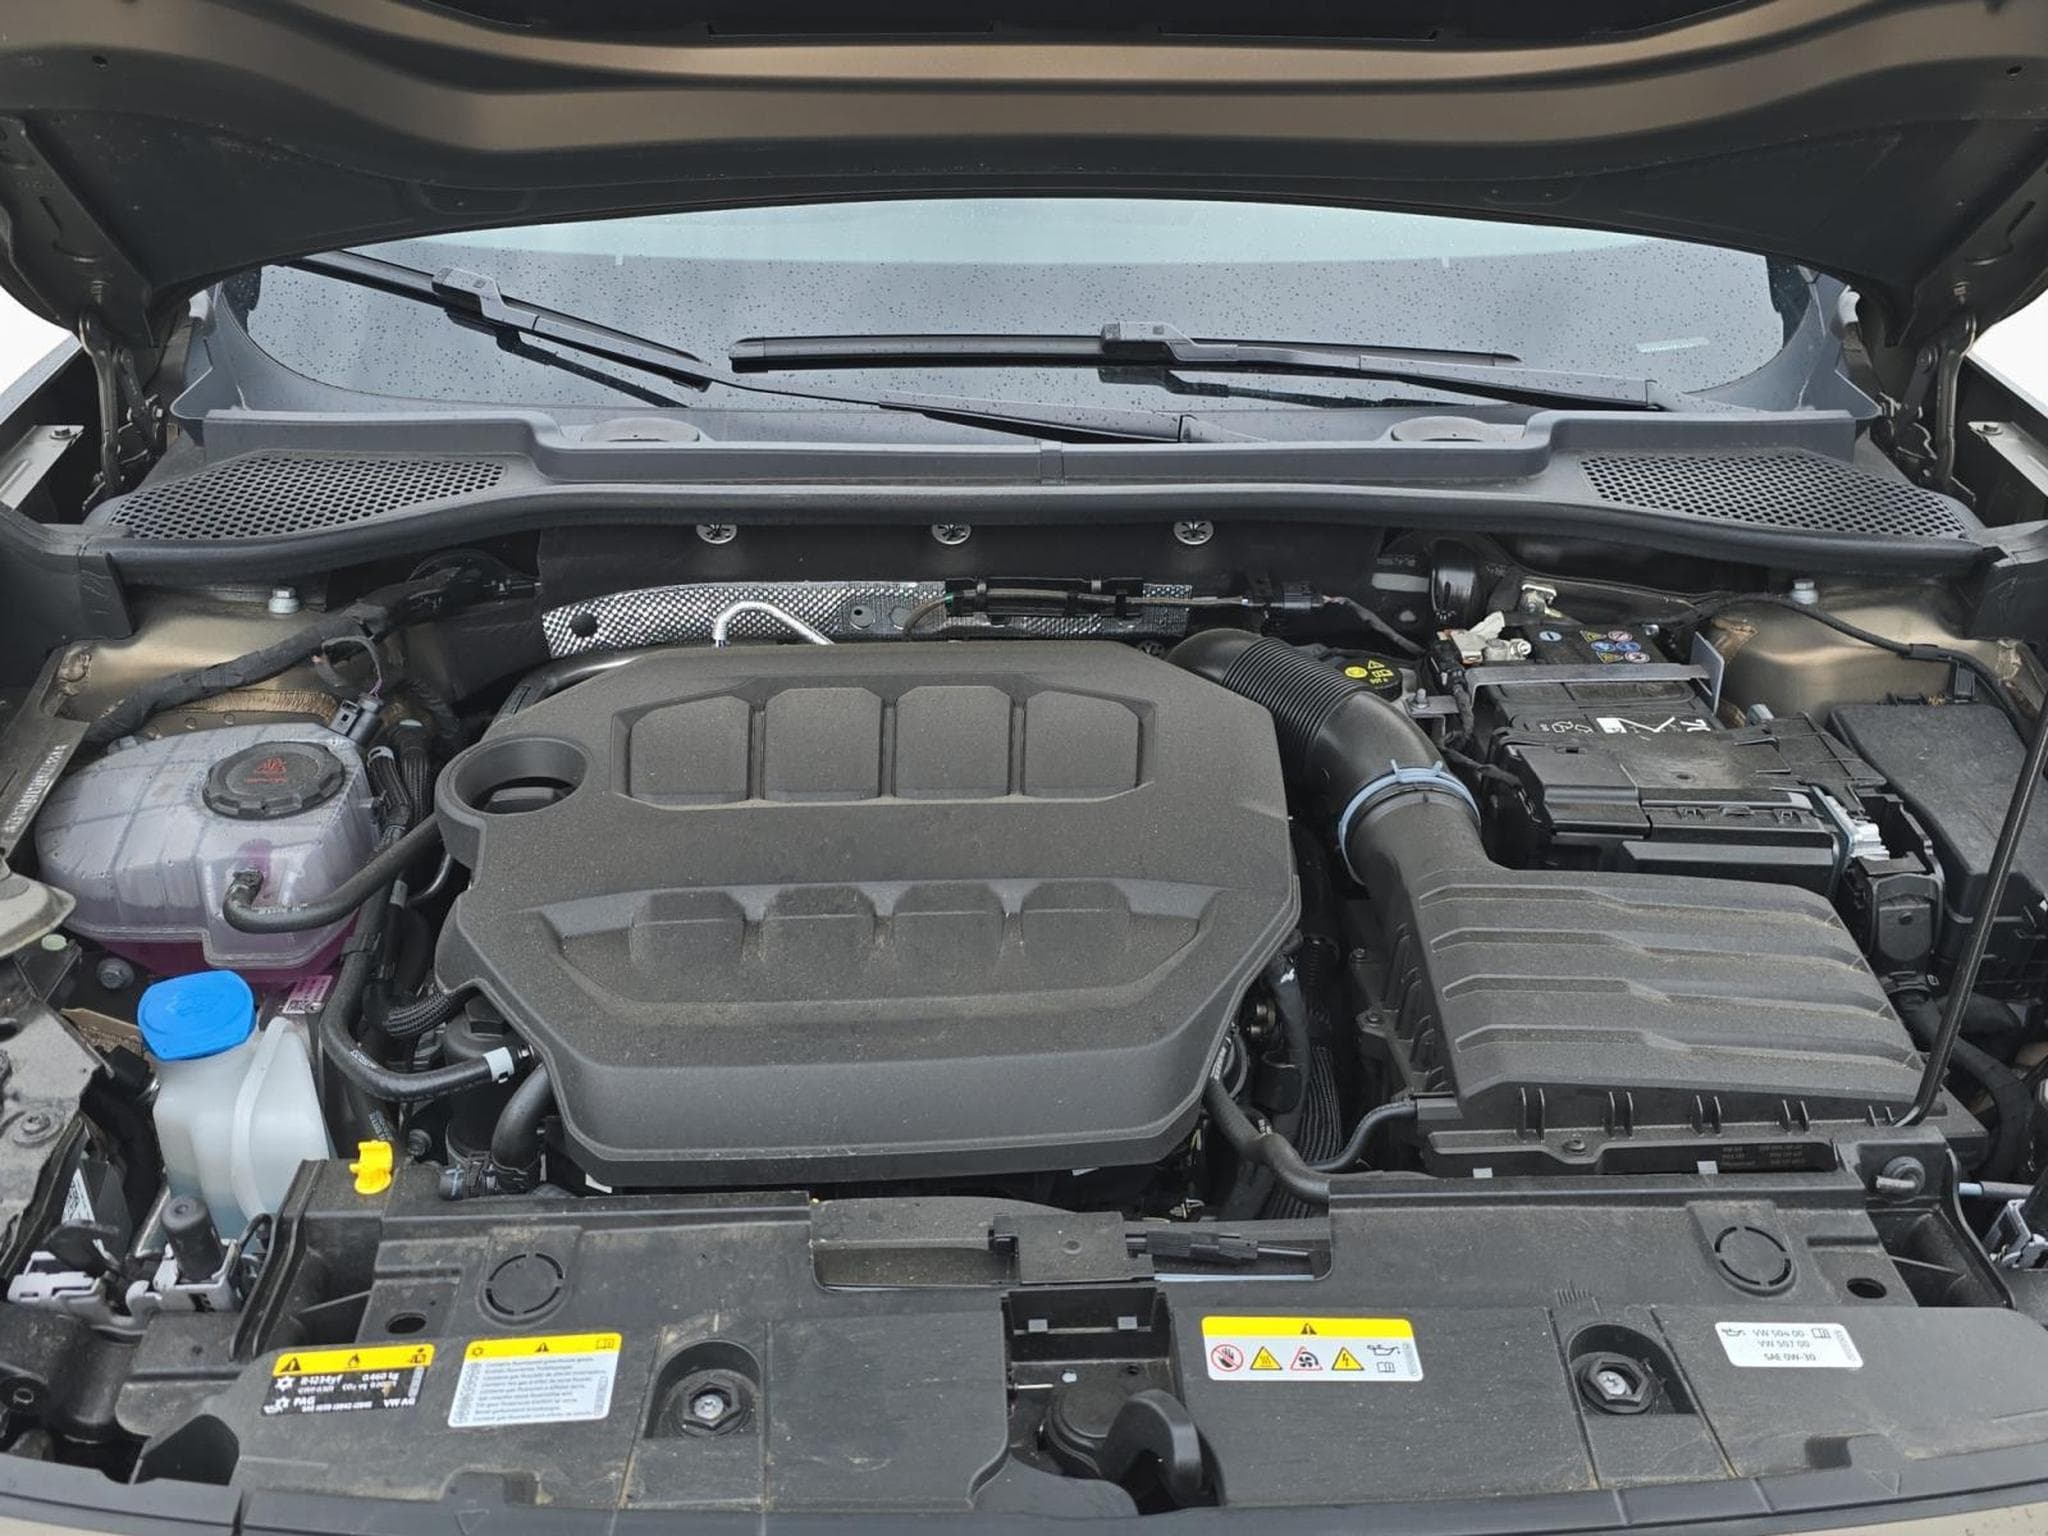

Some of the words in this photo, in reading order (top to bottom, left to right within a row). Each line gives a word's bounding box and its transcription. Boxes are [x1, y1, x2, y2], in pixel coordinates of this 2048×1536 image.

[1752, 1328, 1770, 1338] VW
[1771, 1328, 1791, 1338] 504
[1791, 1328, 1805, 1338] 00
[1757, 1339, 1775, 1348] VW
[1776, 1339, 1794, 1348] 507
[1796, 1339, 1810, 1348] 00
[1763, 1352, 1781, 1361] SAE
[1783, 1352, 1817, 1361] 0W-30
[384, 1398, 401, 1408] VW
